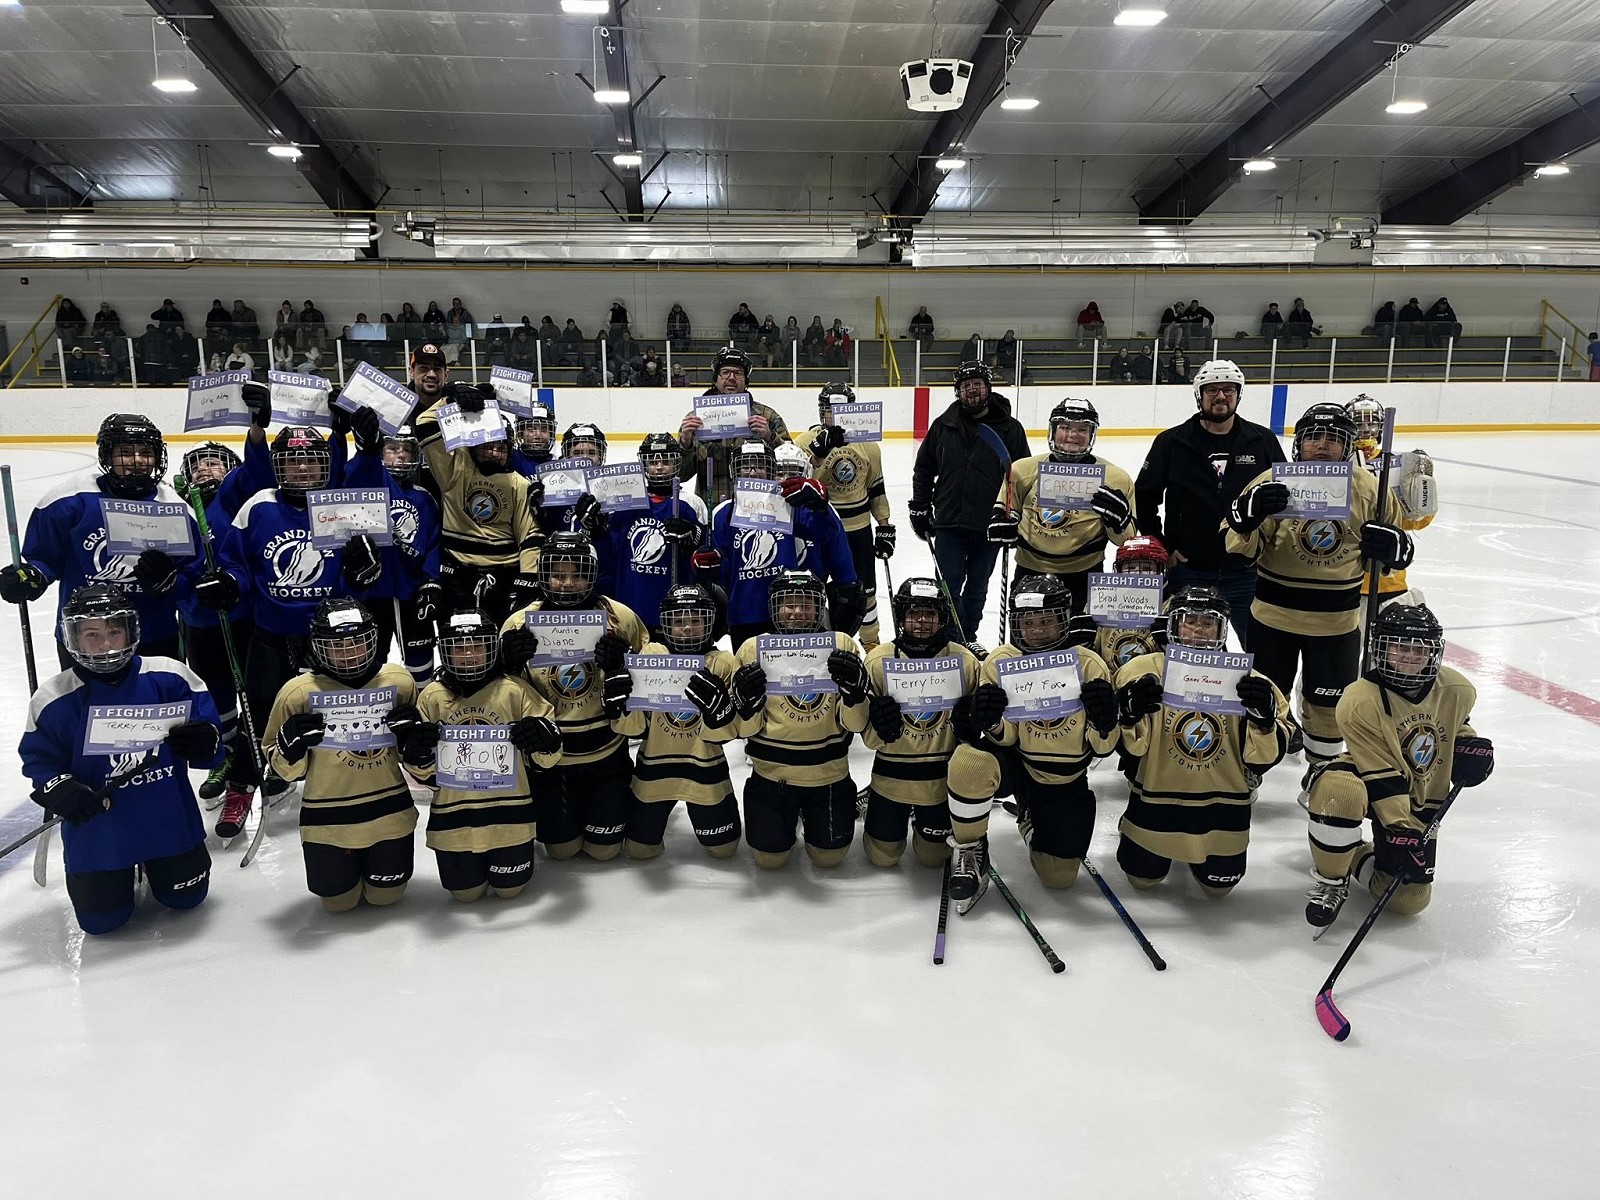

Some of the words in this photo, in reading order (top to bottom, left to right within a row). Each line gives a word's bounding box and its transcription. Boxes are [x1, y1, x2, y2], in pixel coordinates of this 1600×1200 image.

[192, 380, 196, 388] I
[200, 375, 226, 388] FIGHT
[227, 372, 249, 382] FOR
[280, 374, 313, 386] FIGHT
[496, 369, 516, 379] FIGHT
[364, 369, 394, 391] FIGHT
[395, 386, 415, 404] FOR
[702, 397, 728, 406] FIGHT
[730, 396, 746, 404] FOR
[545, 461, 572, 472] FIGHT
[574, 460, 592, 468] FOR
[586, 470, 591, 478] I
[594, 466, 622, 477] FIGHT
[624, 464, 642, 472] FOR
[1040, 464, 1046, 472] I
[1048, 466, 1079, 474] FIGHT
[1082, 467, 1102, 476] FOR
[1275, 466, 1280, 474] I
[1284, 466, 1322, 474] FIGHT
[1325, 466, 1348, 474] FOR
[737, 480, 741, 488] I
[744, 481, 774, 491] FIGHT
[1042, 479, 1095, 494] CARRIE
[310, 495, 316, 504] I
[320, 493, 358, 502] FIGHT
[362, 492, 385, 501] FOR
[104, 501, 110, 510] I
[114, 502, 154, 514] FIGHT
[157, 504, 184, 514] FOR
[1291, 544, 1349, 567] LIGHTNING
[738, 564, 784, 580] HOCKEY
[1092, 576, 1096, 584] I
[1100, 576, 1134, 586] FIGHT
[1138, 578, 1159, 586] FOR
[268, 586, 333, 598] HOCKEY
[528, 614, 534, 624] I
[538, 614, 576, 624] FIGHT
[580, 614, 602, 623] FOR
[408, 638, 433, 647] CCM
[760, 640, 765, 648] I
[770, 638, 806, 648] FIGHT
[810, 636, 832, 646] FOR
[628, 657, 633, 666] I
[636, 658, 674, 667] FIGHT
[676, 658, 700, 668] FOR
[999, 663, 1004, 673] I
[1007, 656, 1046, 672] FIGHT
[1050, 653, 1074, 666] FOR
[1169, 650, 1174, 658] I
[1180, 652, 1220, 665] FIGHT
[1224, 656, 1249, 667] FOR
[885, 662, 891, 670] I
[894, 662, 931, 672] FIGHT
[934, 658, 959, 670] FOR
[892, 678, 927, 693] Terry
[930, 676, 946, 684] Fox
[312, 695, 319, 705] I
[324, 694, 365, 705] FIGHT
[369, 690, 392, 702] FOR
[1314, 687, 1343, 696] BAU
[94, 708, 100, 717] I
[106, 708, 154, 718] FIGHT
[158, 705, 186, 717] FOR
[445, 730, 486, 740] FIGHT
[1456, 745, 1493, 757] AUER
[1168, 748, 1227, 771] LIGHTNING
[696, 822, 734, 836] BAUER
[922, 827, 953, 836] CCM
[1386, 834, 1420, 846] UER
[490, 860, 531, 874] BAUER
[173, 870, 207, 890] CCM
[370, 872, 405, 882] CCM
[1208, 873, 1242, 882] CCM
